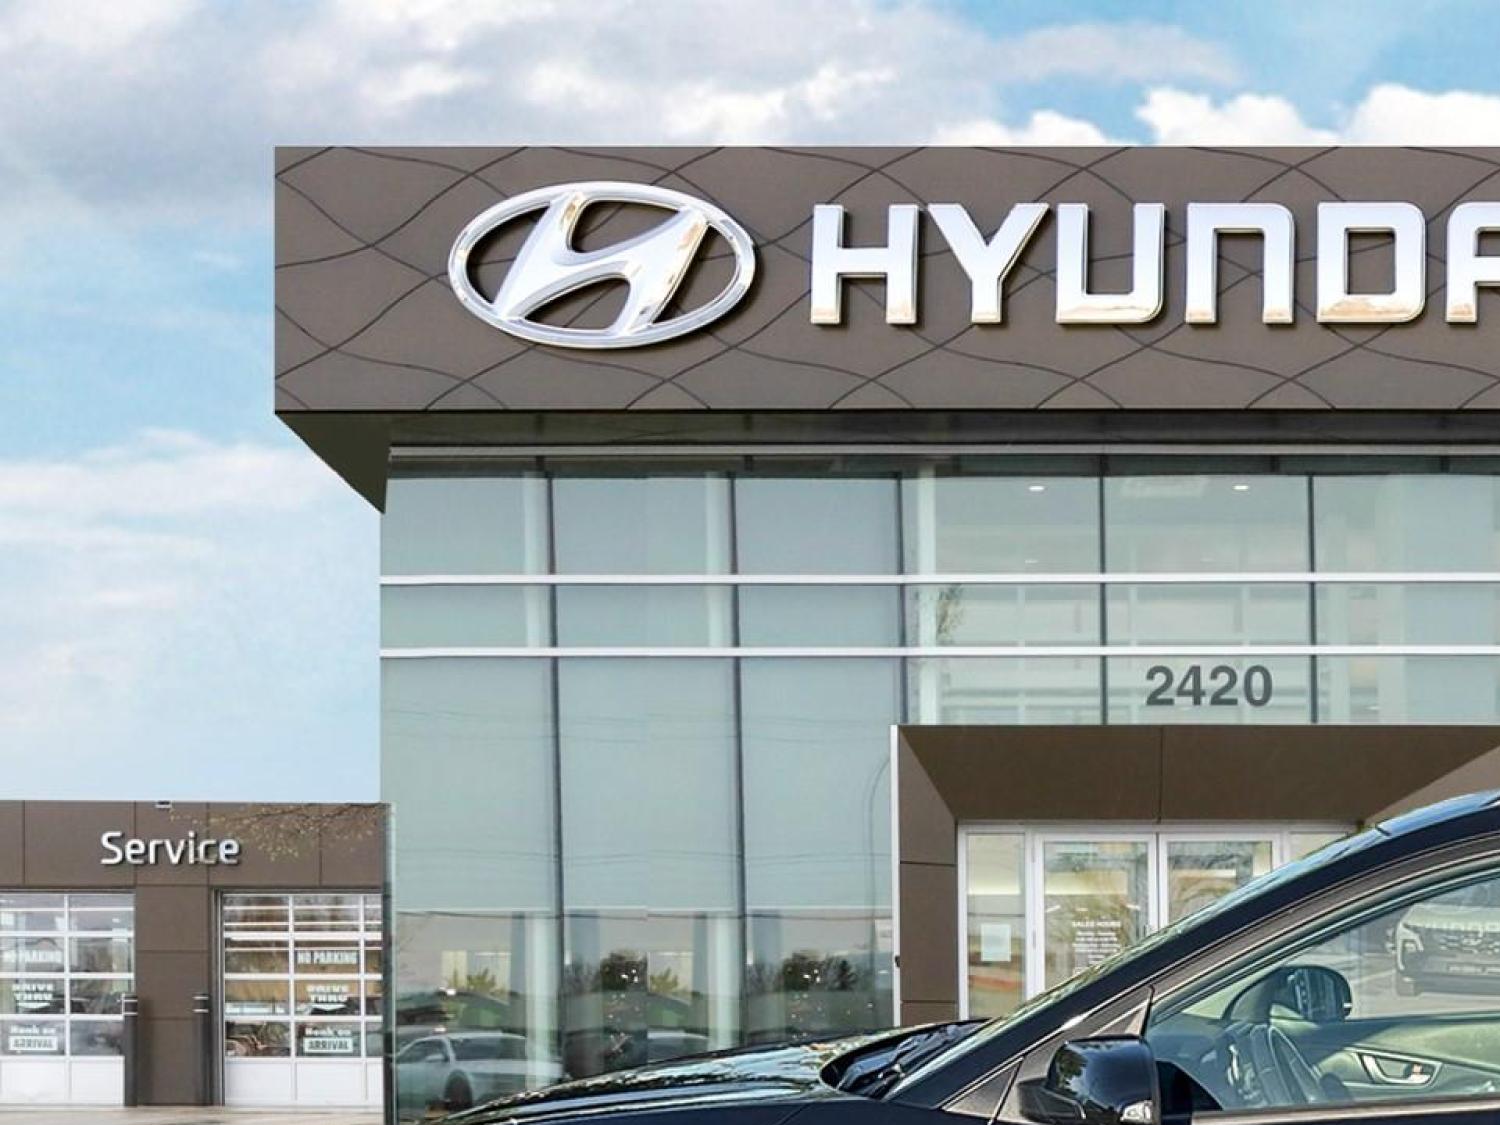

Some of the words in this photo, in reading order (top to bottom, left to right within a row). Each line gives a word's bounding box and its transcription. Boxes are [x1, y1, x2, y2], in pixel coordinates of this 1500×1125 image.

[1145, 665, 1274, 708] 2420
[100, 830, 240, 866] Service
[313, 951, 357, 964] PARKING
[308, 1040, 350, 1050] ARRIVAL
